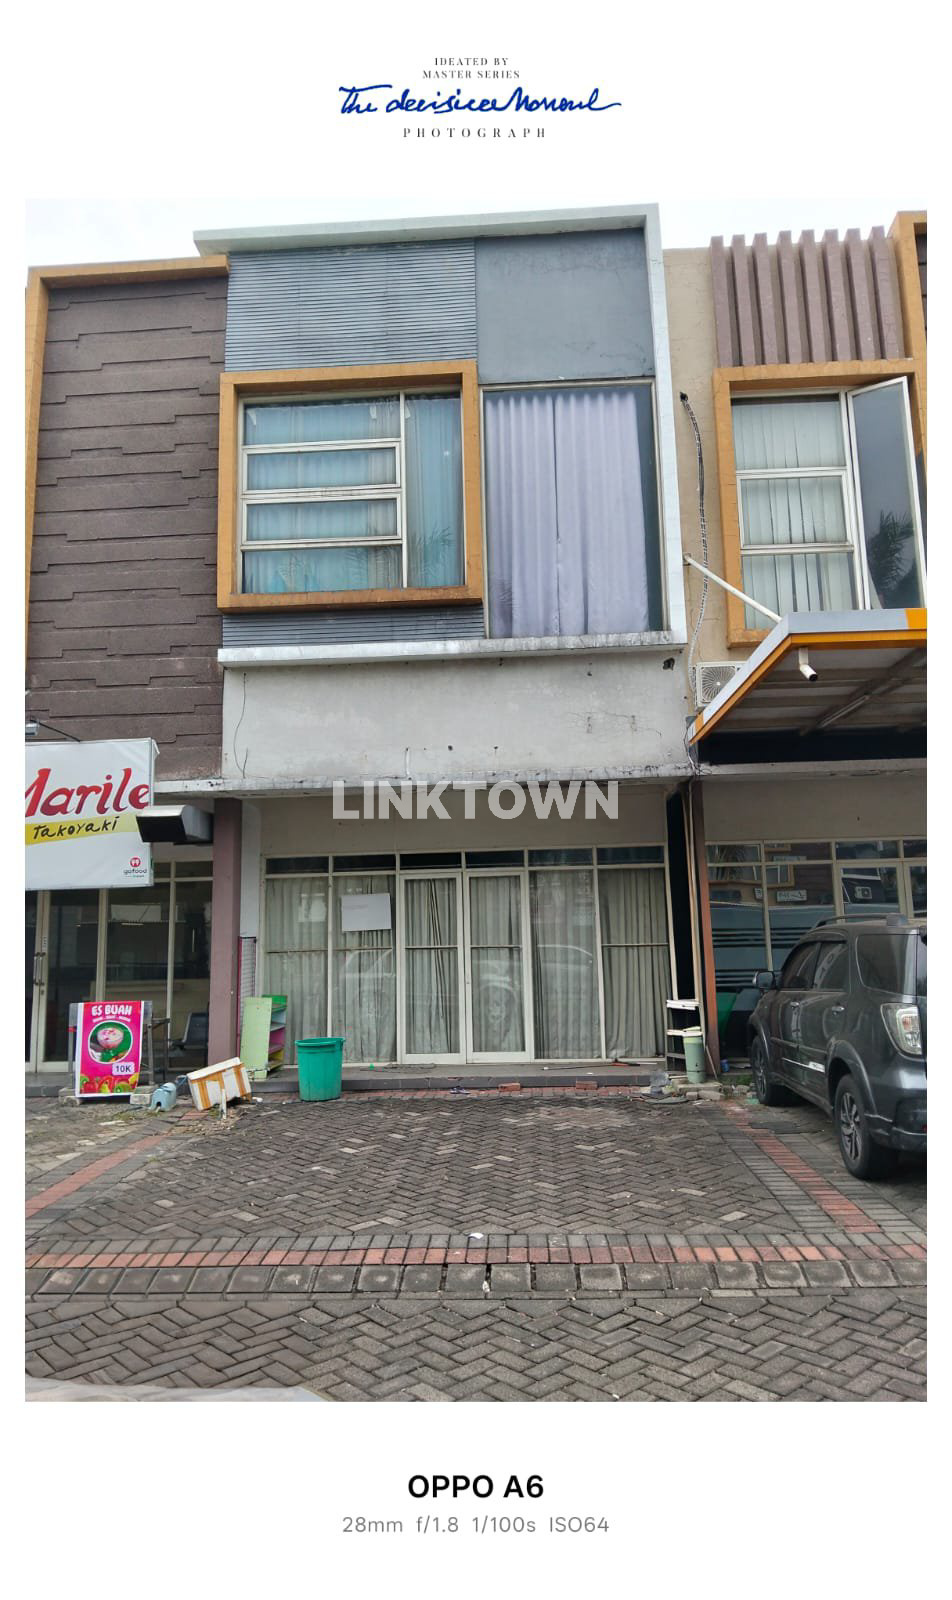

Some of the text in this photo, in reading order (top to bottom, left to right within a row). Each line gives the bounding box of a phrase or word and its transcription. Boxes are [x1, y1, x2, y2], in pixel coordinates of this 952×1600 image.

[91, 1004, 133, 1016] ES BUAH
[115, 1065, 131, 1073] 10K
